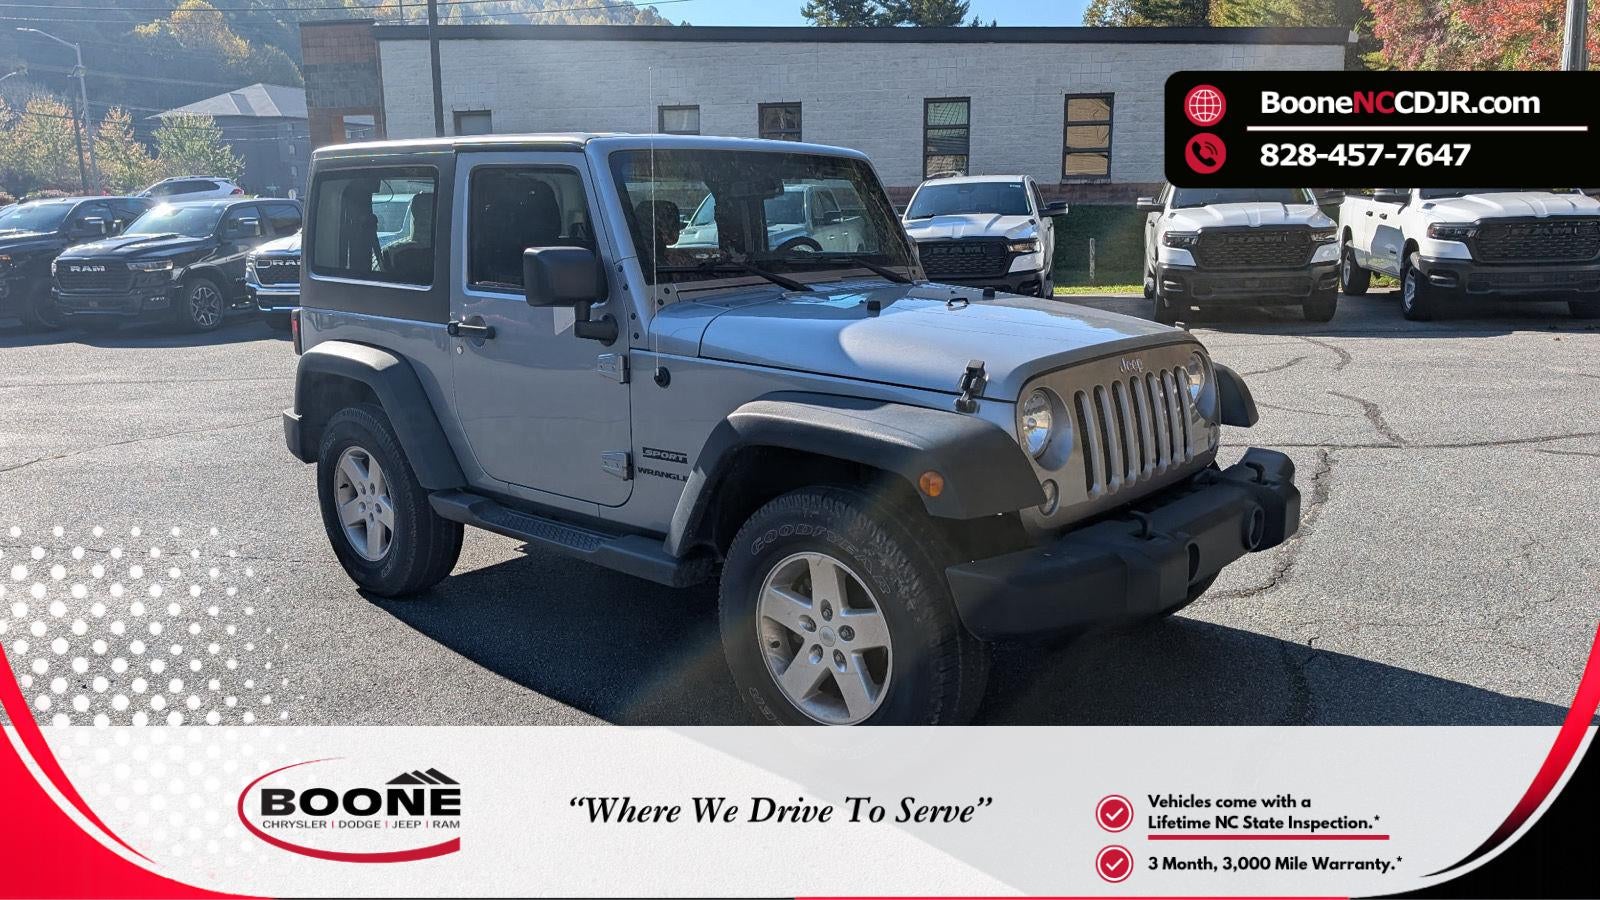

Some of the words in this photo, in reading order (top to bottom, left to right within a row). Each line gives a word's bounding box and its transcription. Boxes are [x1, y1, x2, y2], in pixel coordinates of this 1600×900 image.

[69, 264, 106, 273] RAM
[1119, 357, 1143, 373] Jeep
[643, 448, 687, 463] SPORT
